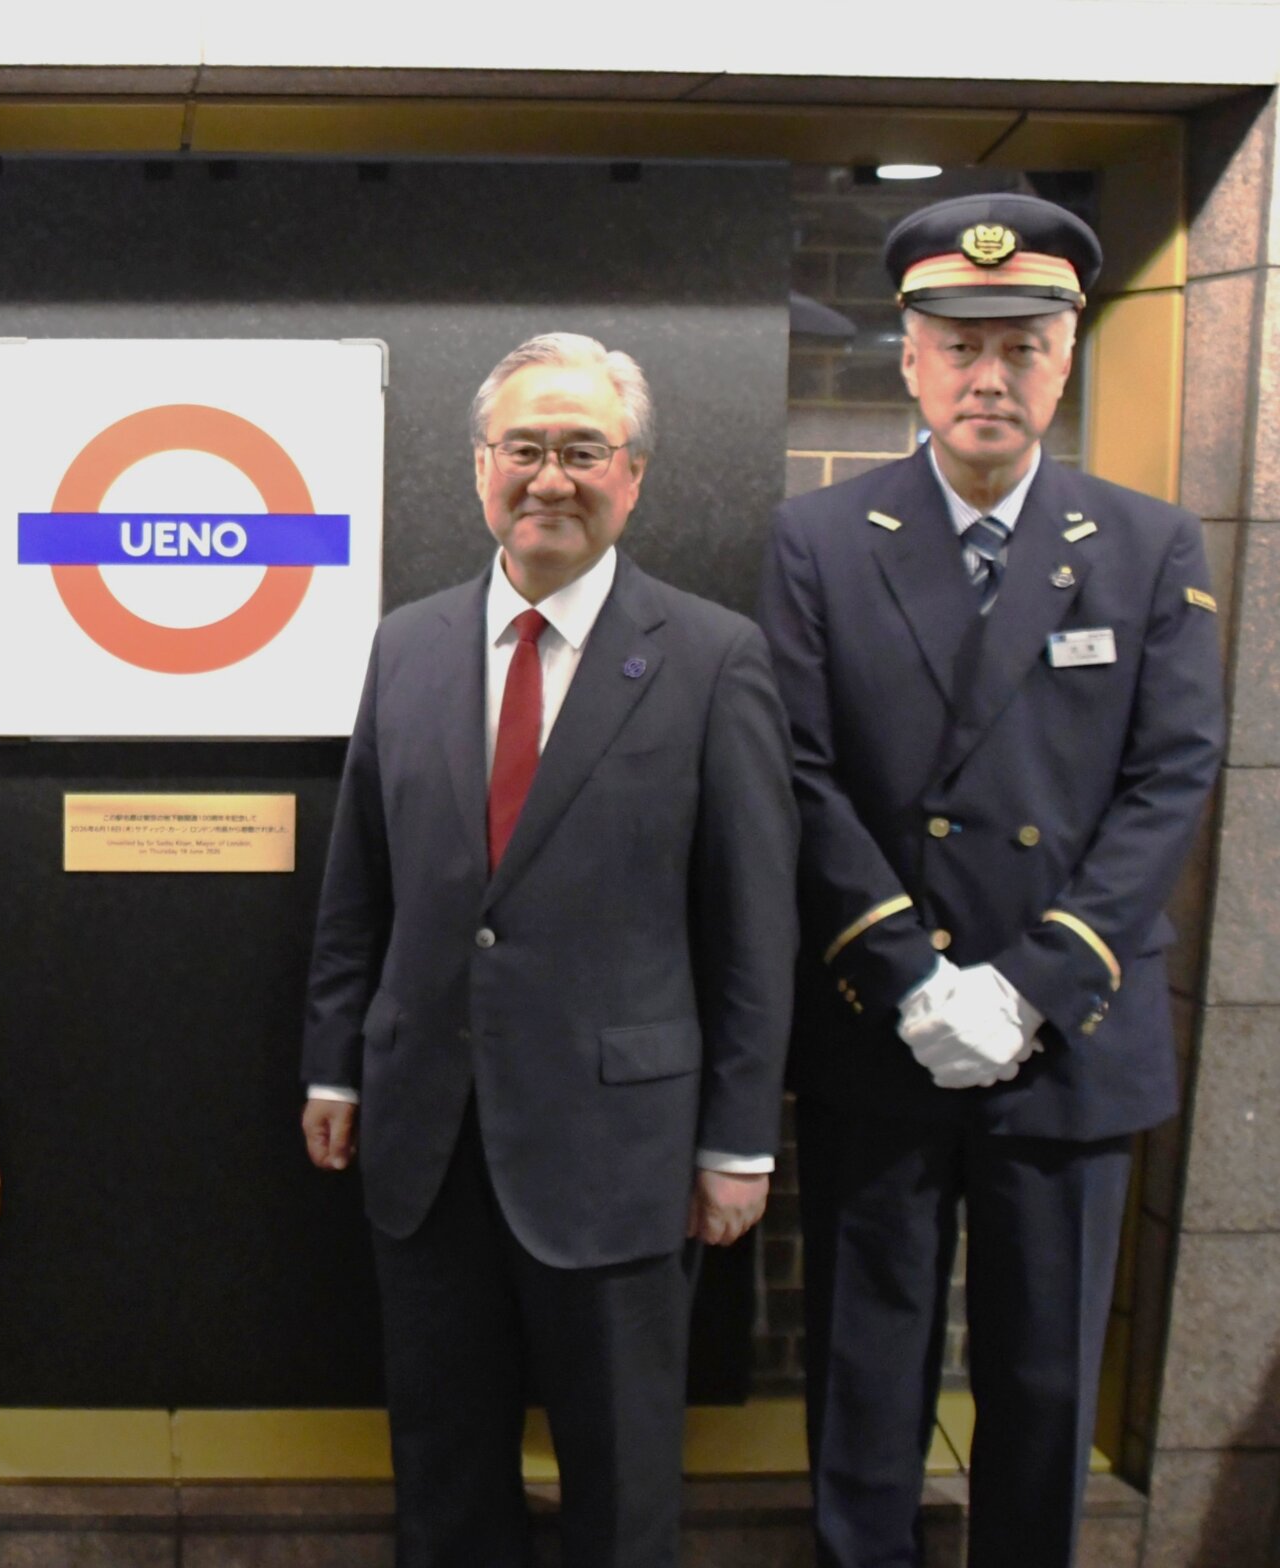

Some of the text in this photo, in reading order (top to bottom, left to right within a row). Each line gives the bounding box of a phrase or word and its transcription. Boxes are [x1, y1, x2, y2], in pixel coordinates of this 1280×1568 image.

[121, 522, 247, 557] UENO
[195, 840, 216, 848] Mayor
[148, 848, 177, 856] Thursday
